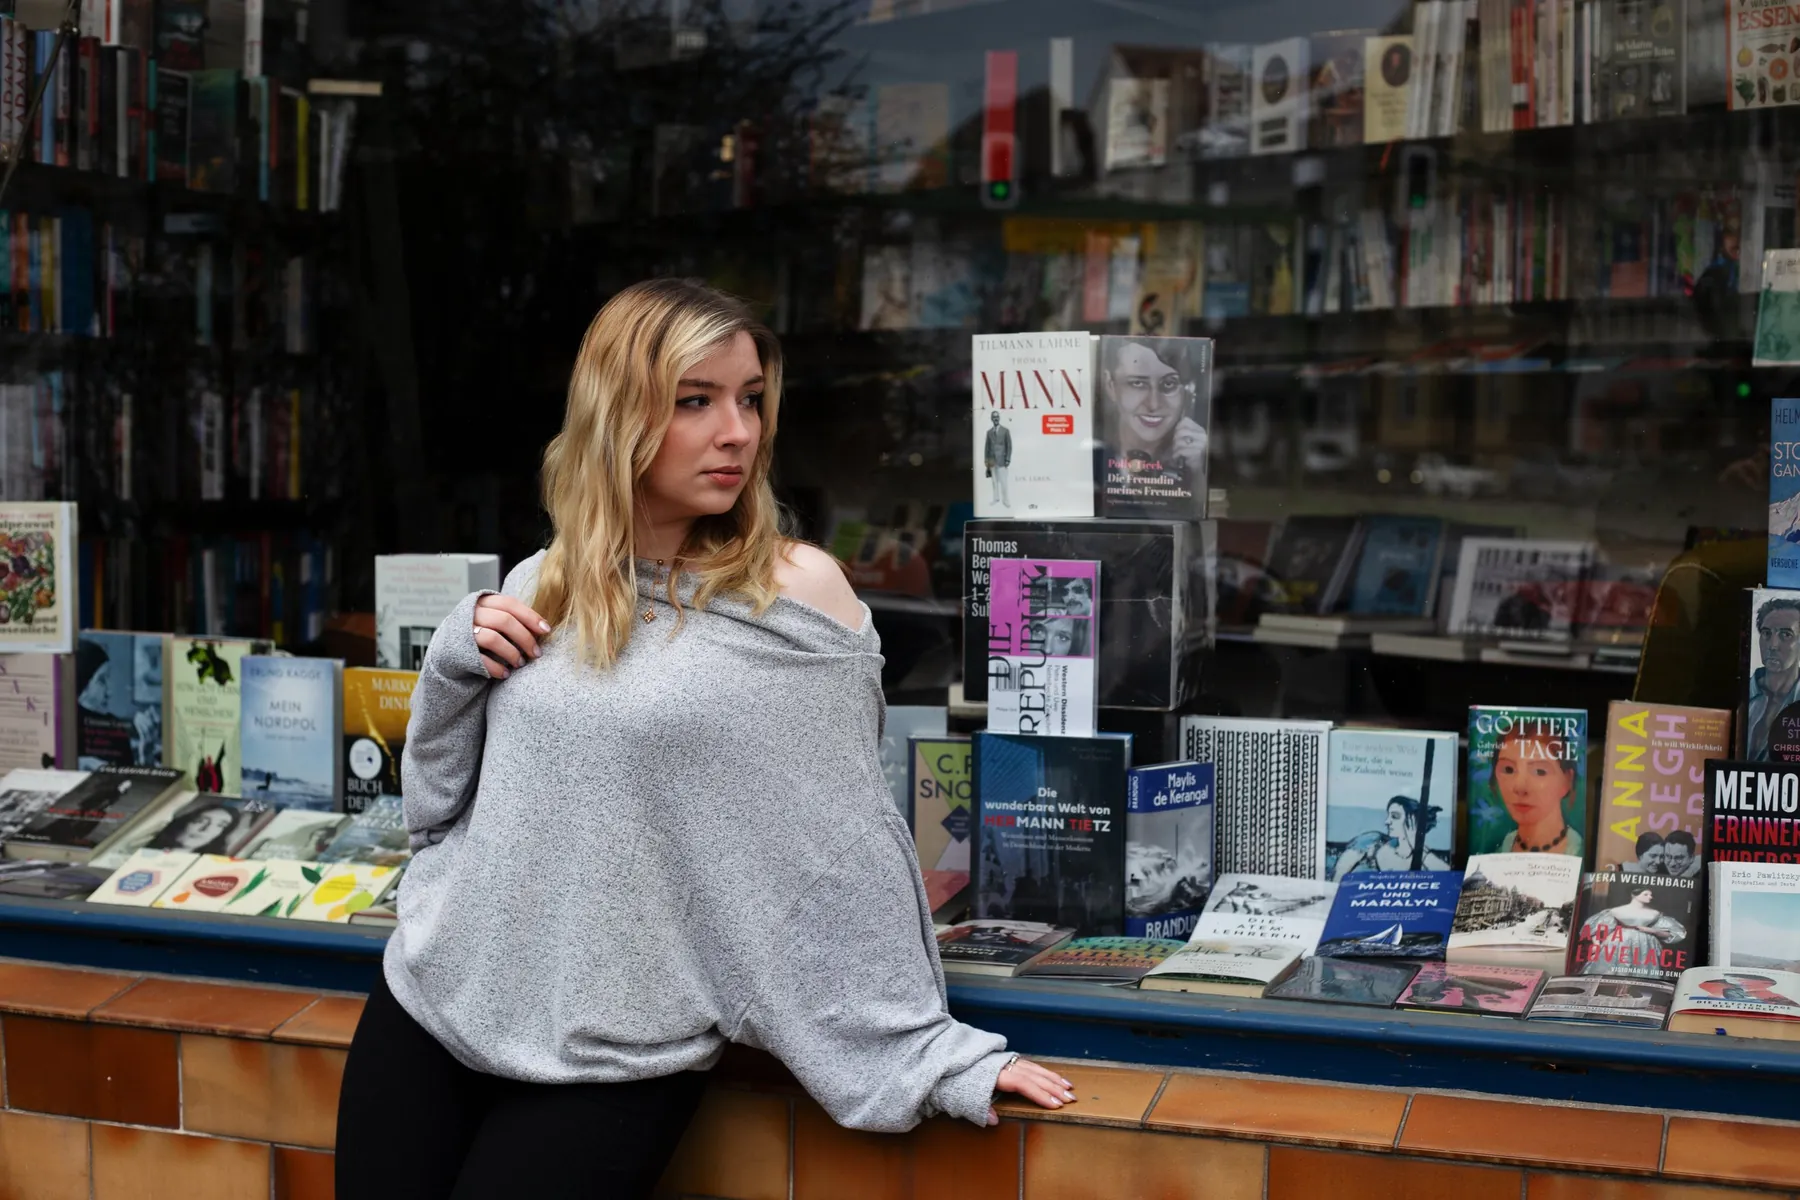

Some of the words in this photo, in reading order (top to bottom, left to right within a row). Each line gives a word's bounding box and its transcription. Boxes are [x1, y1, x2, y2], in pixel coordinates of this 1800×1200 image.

[980, 340, 1033, 351] TILMANN
[1039, 338, 1081, 349] LAHME
[1011, 357, 1048, 365] THOMAS
[980, 369, 1082, 410] MANN
[1107, 473, 1124, 484] Die
[1126, 474, 1174, 485] Freundin
[1106, 486, 1142, 495] meines
[1143, 486, 1192, 497] Freundes
[972, 537, 1018, 553] Thomas
[987, 622, 1011, 680] DIE
[1017, 565, 1048, 735] REPUBLIK
[1060, 665, 1068, 697] Western
[269, 699, 301, 713] MEIN
[379, 695, 410, 711] DINI
[254, 716, 317, 731] NORDPOL
[1059, 698, 1067, 735] Dissidenz
[1476, 711, 1579, 737] GÖTTER
[1514, 739, 1579, 761] TAGE
[1651, 739, 1662, 747] Ich
[1664, 740, 1677, 748] will
[1678, 741, 1723, 752] Wirklichkeit
[1167, 771, 1197, 791] Maylis
[1610, 710, 1649, 844] ANNA
[347, 778, 383, 794] BUCH
[1037, 787, 1058, 798] Die
[1153, 790, 1168, 807] de
[1169, 784, 1209, 805] Kerangal
[984, 801, 1055, 812] wunderbare
[1057, 802, 1086, 814] Welt
[1089, 806, 1111, 815] von
[984, 814, 1065, 830] HERMANN
[1069, 818, 1111, 832] TIETZ
[1589, 872, 1616, 883] VERA
[1620, 874, 1694, 889] WEIDENBACH
[1731, 871, 1752, 879] Eric
[1757, 872, 1800, 882] Pawlitzky
[1358, 882, 1441, 890] MAURICE
[1350, 899, 1438, 908] MARALYN
[1213, 929, 1301, 939] LEHRERIN
[1236, 924, 1283, 932] ATEM
[1579, 923, 1624, 942] ADA
[1575, 943, 1688, 970] LOVELACE
[1611, 965, 1649, 975] VISIONÄRIN
[1665, 970, 1682, 978] GENI
